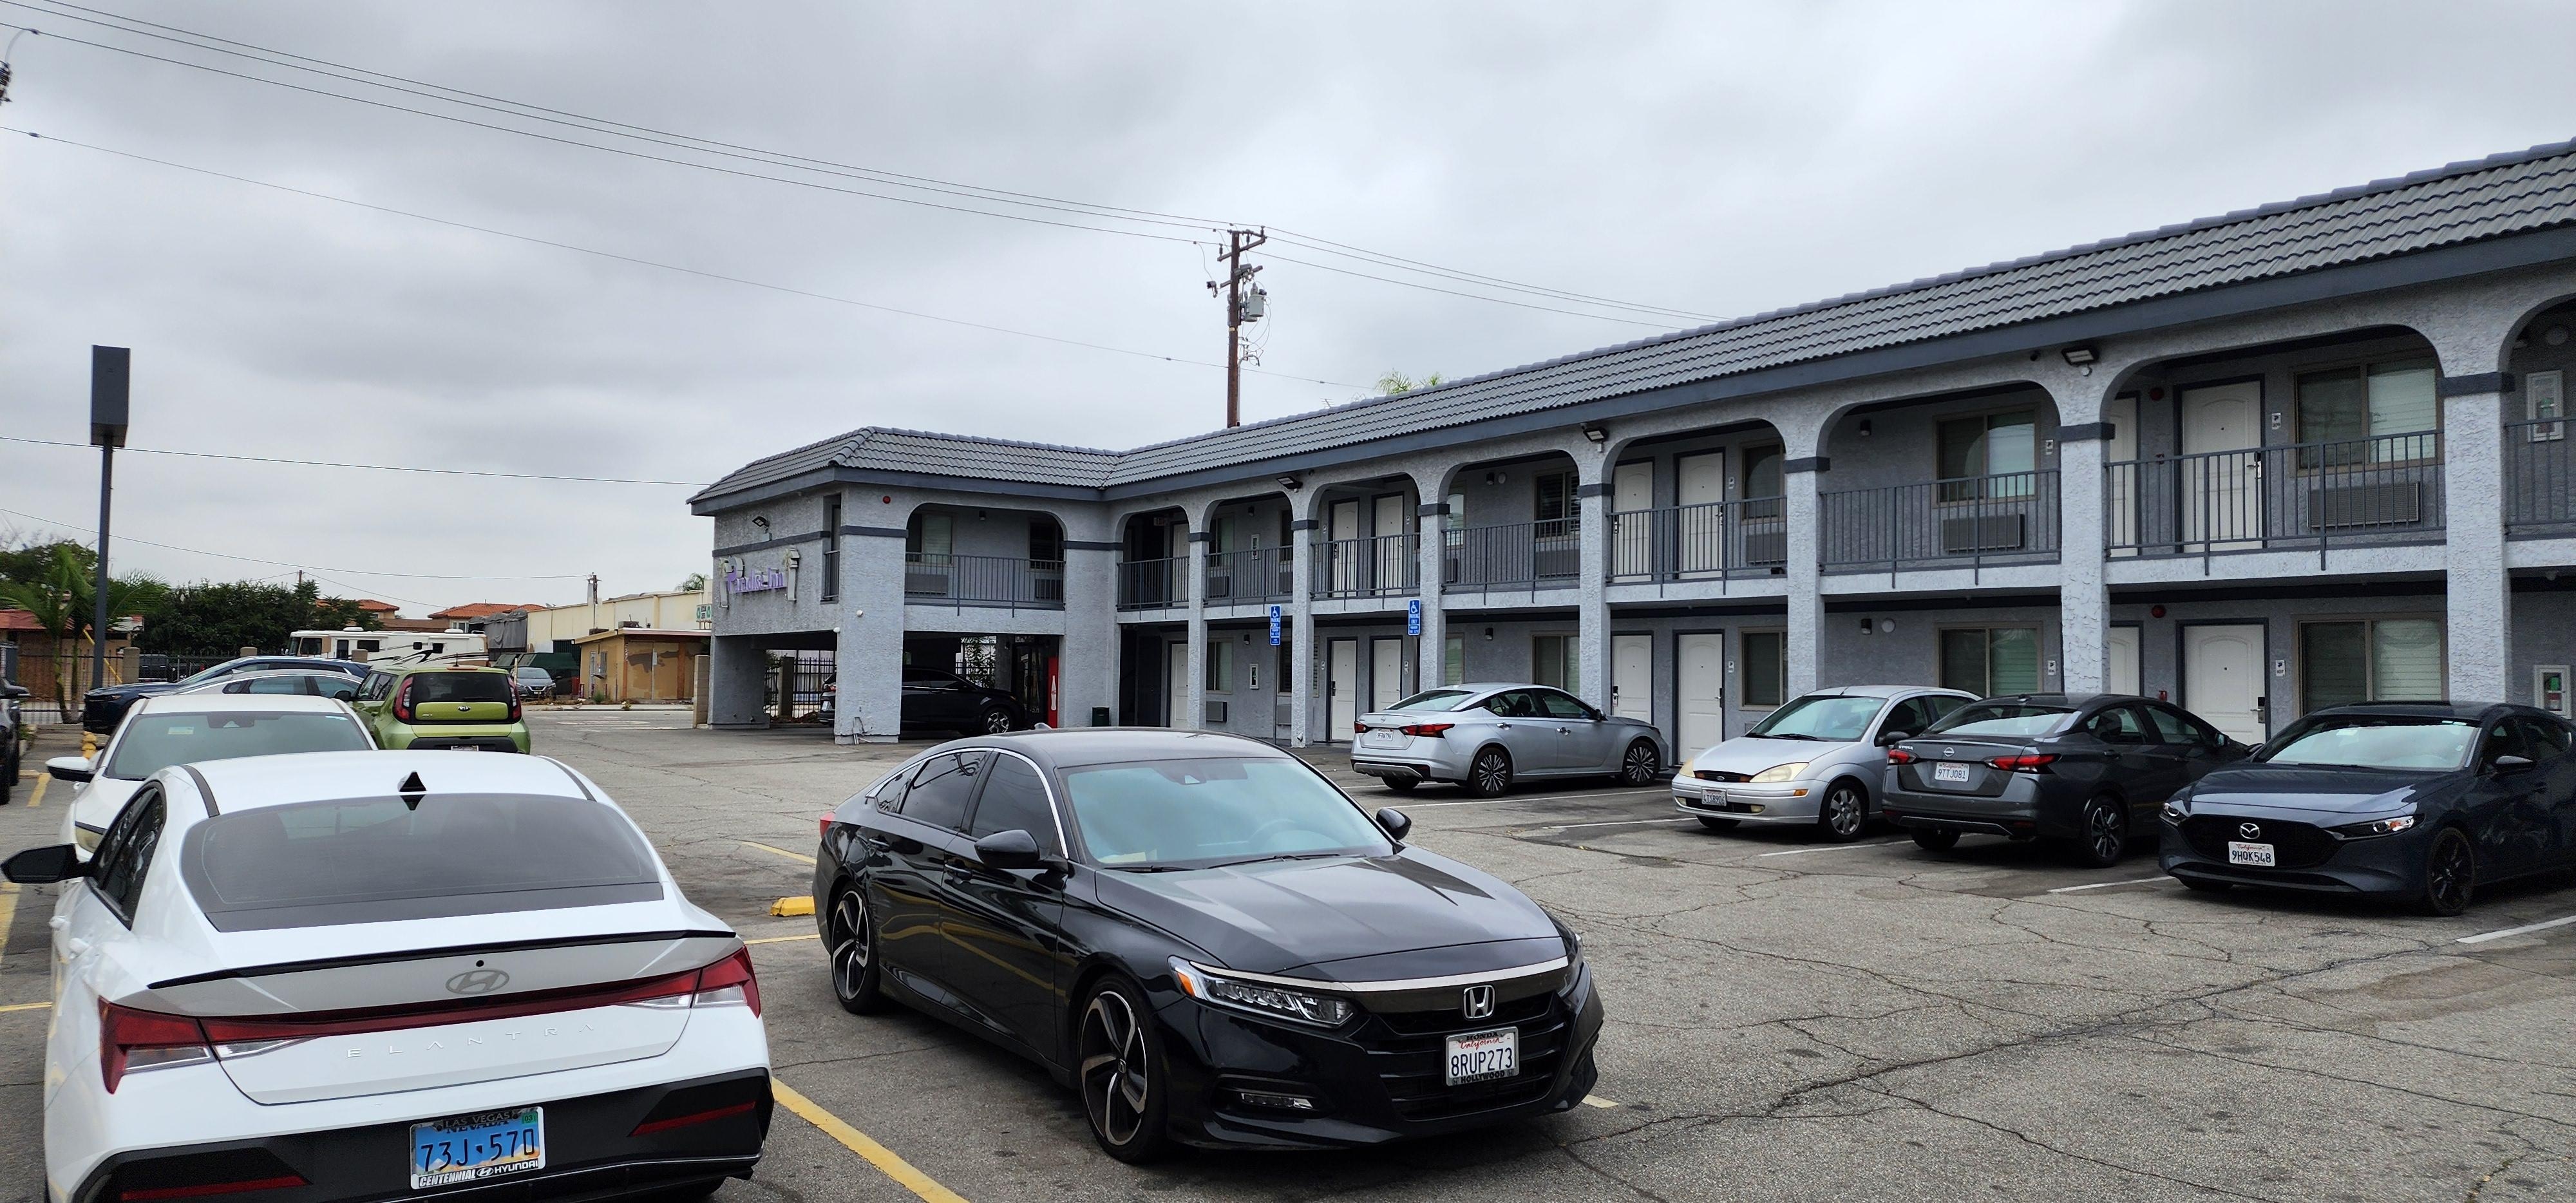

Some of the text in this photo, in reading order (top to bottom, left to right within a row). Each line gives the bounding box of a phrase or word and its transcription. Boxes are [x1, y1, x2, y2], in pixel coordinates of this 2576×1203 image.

[726, 556, 784, 592] Paradise Inn
[1938, 768, 1965, 779] 9TTJ081
[346, 1024, 594, 1058] ELANTRA
[1459, 1037, 1504, 1050] California
[1466, 1032, 1499, 1041] HONDA
[1451, 1047, 1513, 1077] 8RUP273
[1461, 1070, 1505, 1083] HOLLYWOOD
[445, 1112, 510, 1128] LAS VEGAS
[419, 1160, 539, 1188] CENTENNIAL HYUNDAI
